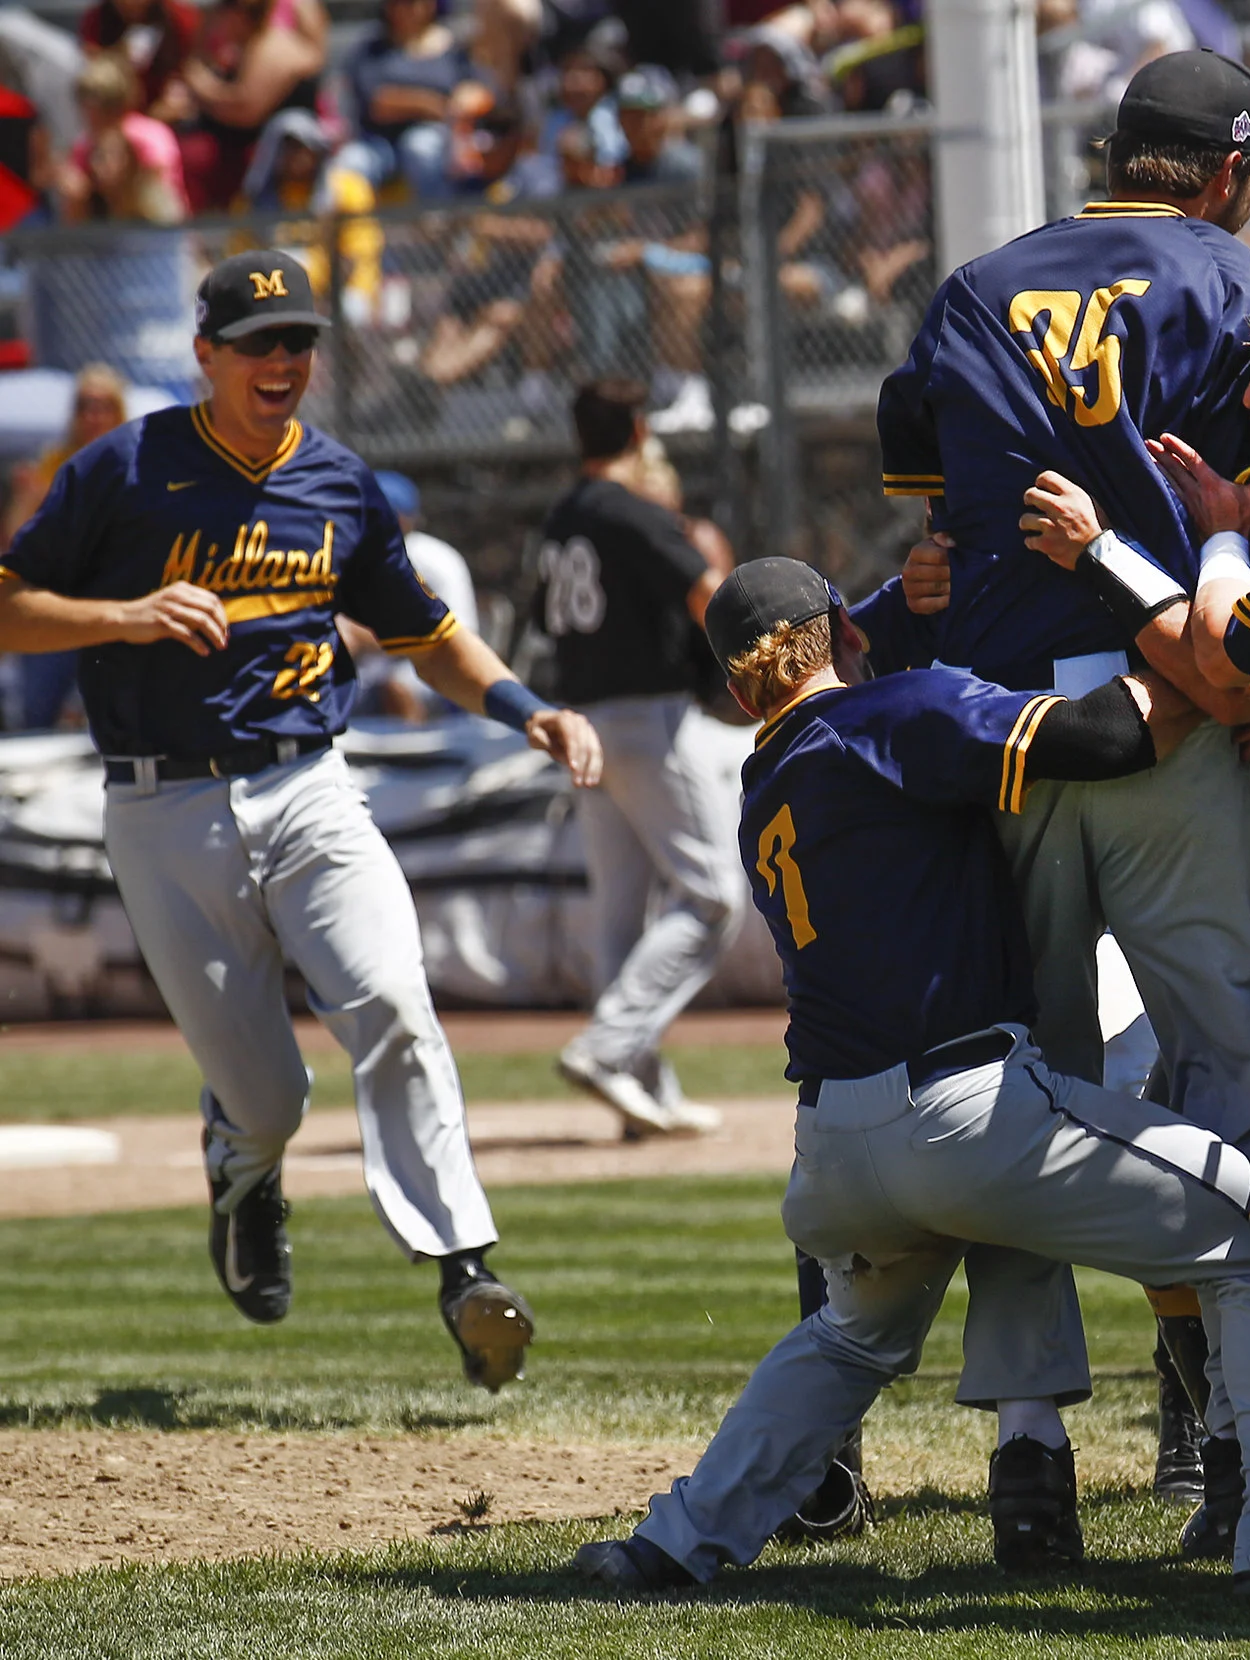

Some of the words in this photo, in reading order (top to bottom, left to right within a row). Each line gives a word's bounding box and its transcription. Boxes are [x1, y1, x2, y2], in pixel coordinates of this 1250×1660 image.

[249, 268, 289, 300] M
[157, 519, 338, 592] Midland
[756, 803, 818, 950] 7
